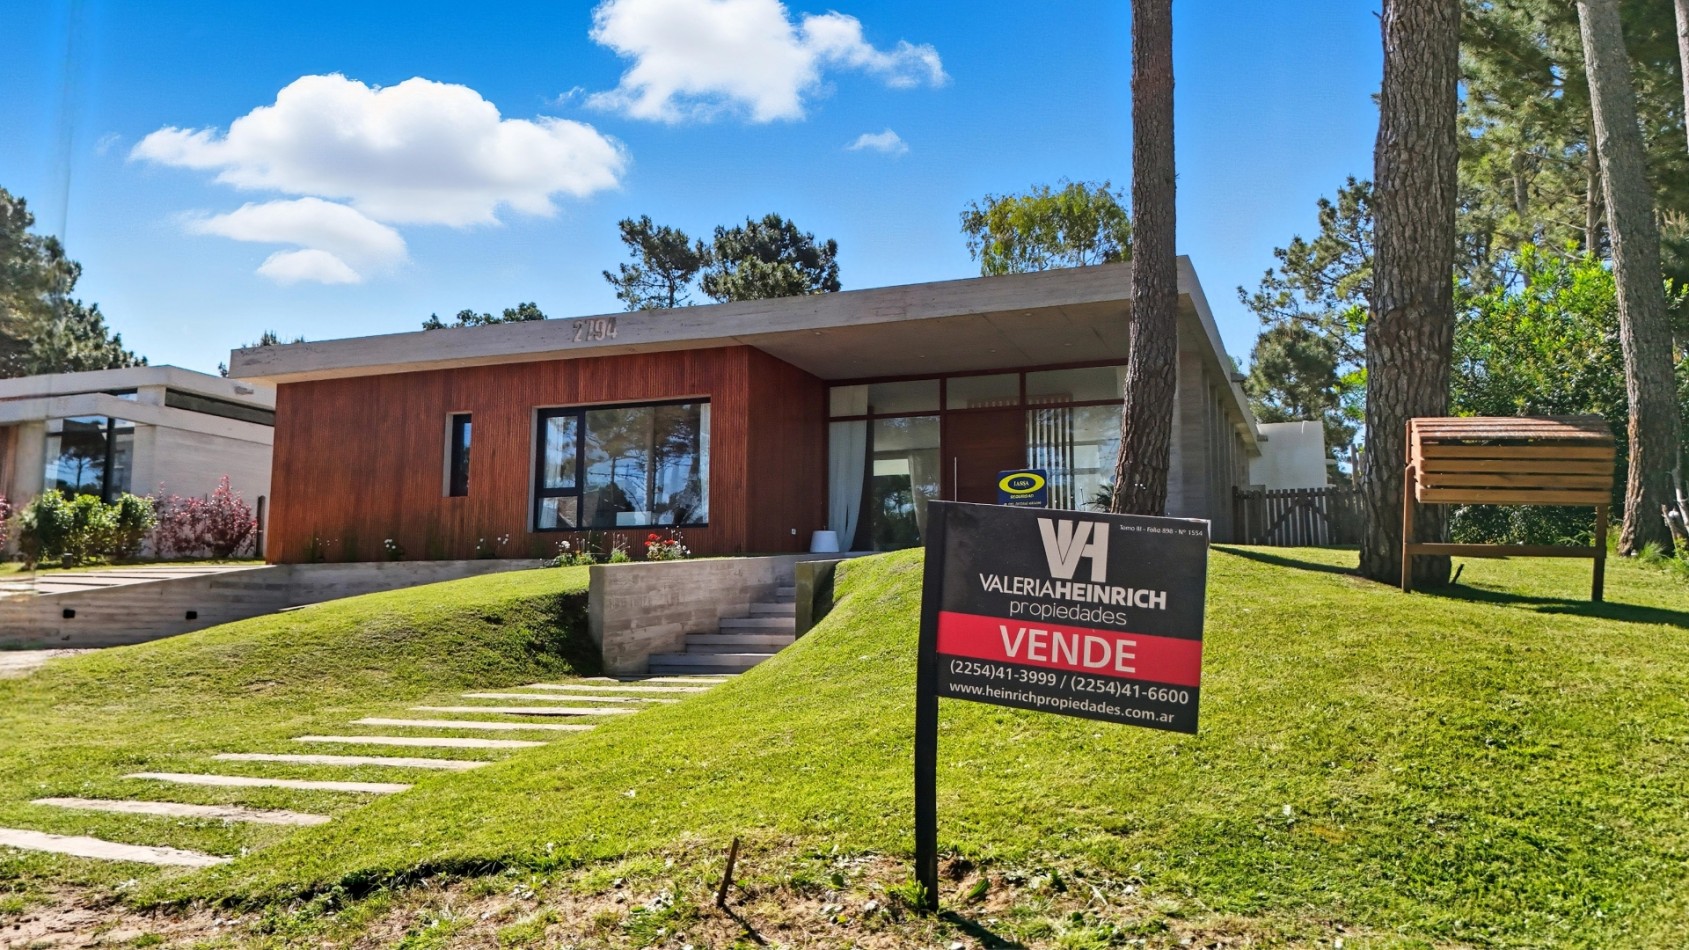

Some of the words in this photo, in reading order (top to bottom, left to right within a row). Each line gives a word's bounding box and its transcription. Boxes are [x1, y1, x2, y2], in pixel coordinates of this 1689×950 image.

[572, 317, 618, 342] 2794
[1009, 600, 1127, 626] propiedades
[999, 624, 1137, 673] VENDE
[949, 682, 1175, 723] www.heinrichpropiedades.com.ar
[950, 659, 1057, 687] (2254)41-3999
[1070, 676, 1189, 705] (2254)41-6600
